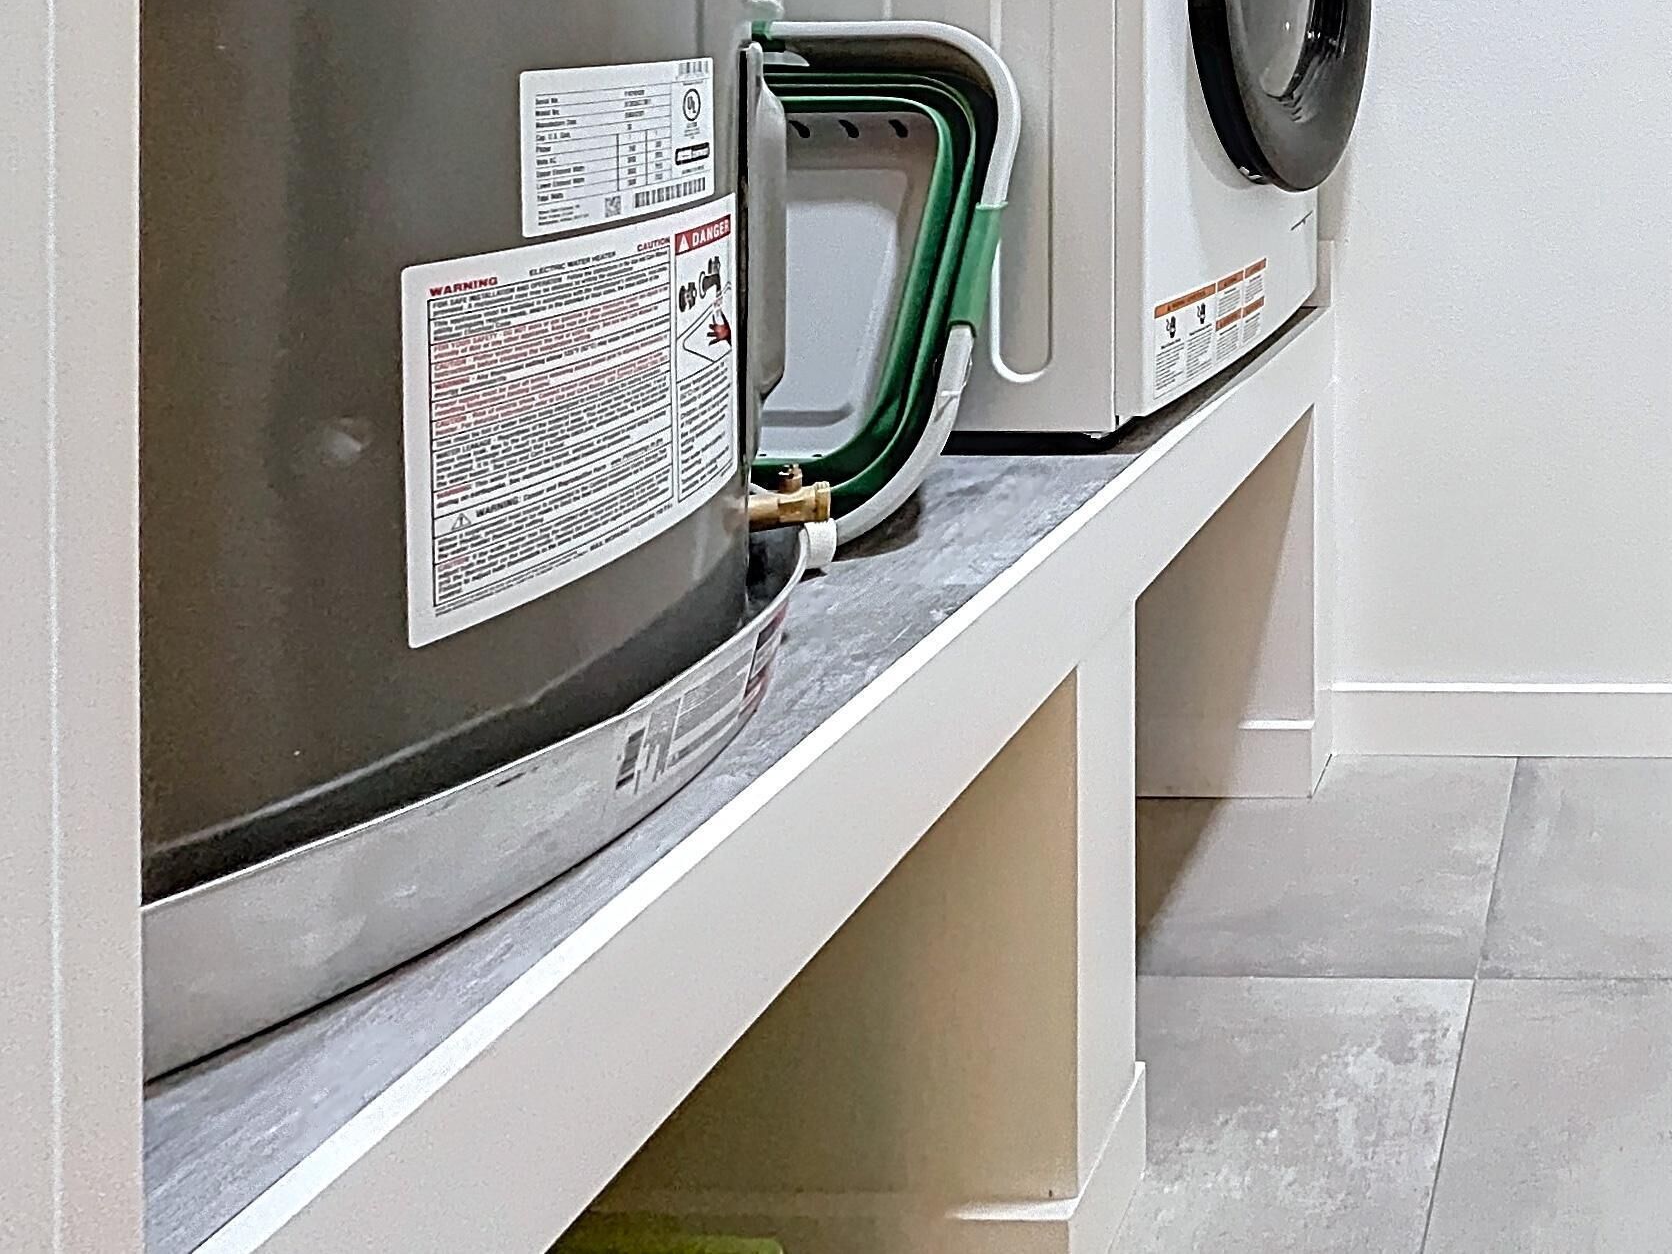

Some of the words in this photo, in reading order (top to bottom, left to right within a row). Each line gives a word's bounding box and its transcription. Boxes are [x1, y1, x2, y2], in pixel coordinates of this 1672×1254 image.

[692, 219, 730, 247] DANGER
[429, 276, 498, 297] WARNING
[529, 262, 566, 276] ELECTRIC
[567, 257, 591, 267] WATER
[591, 251, 616, 262] HEATER
[637, 237, 671, 252] CAUTION
[476, 496, 521, 517] WARNING:
